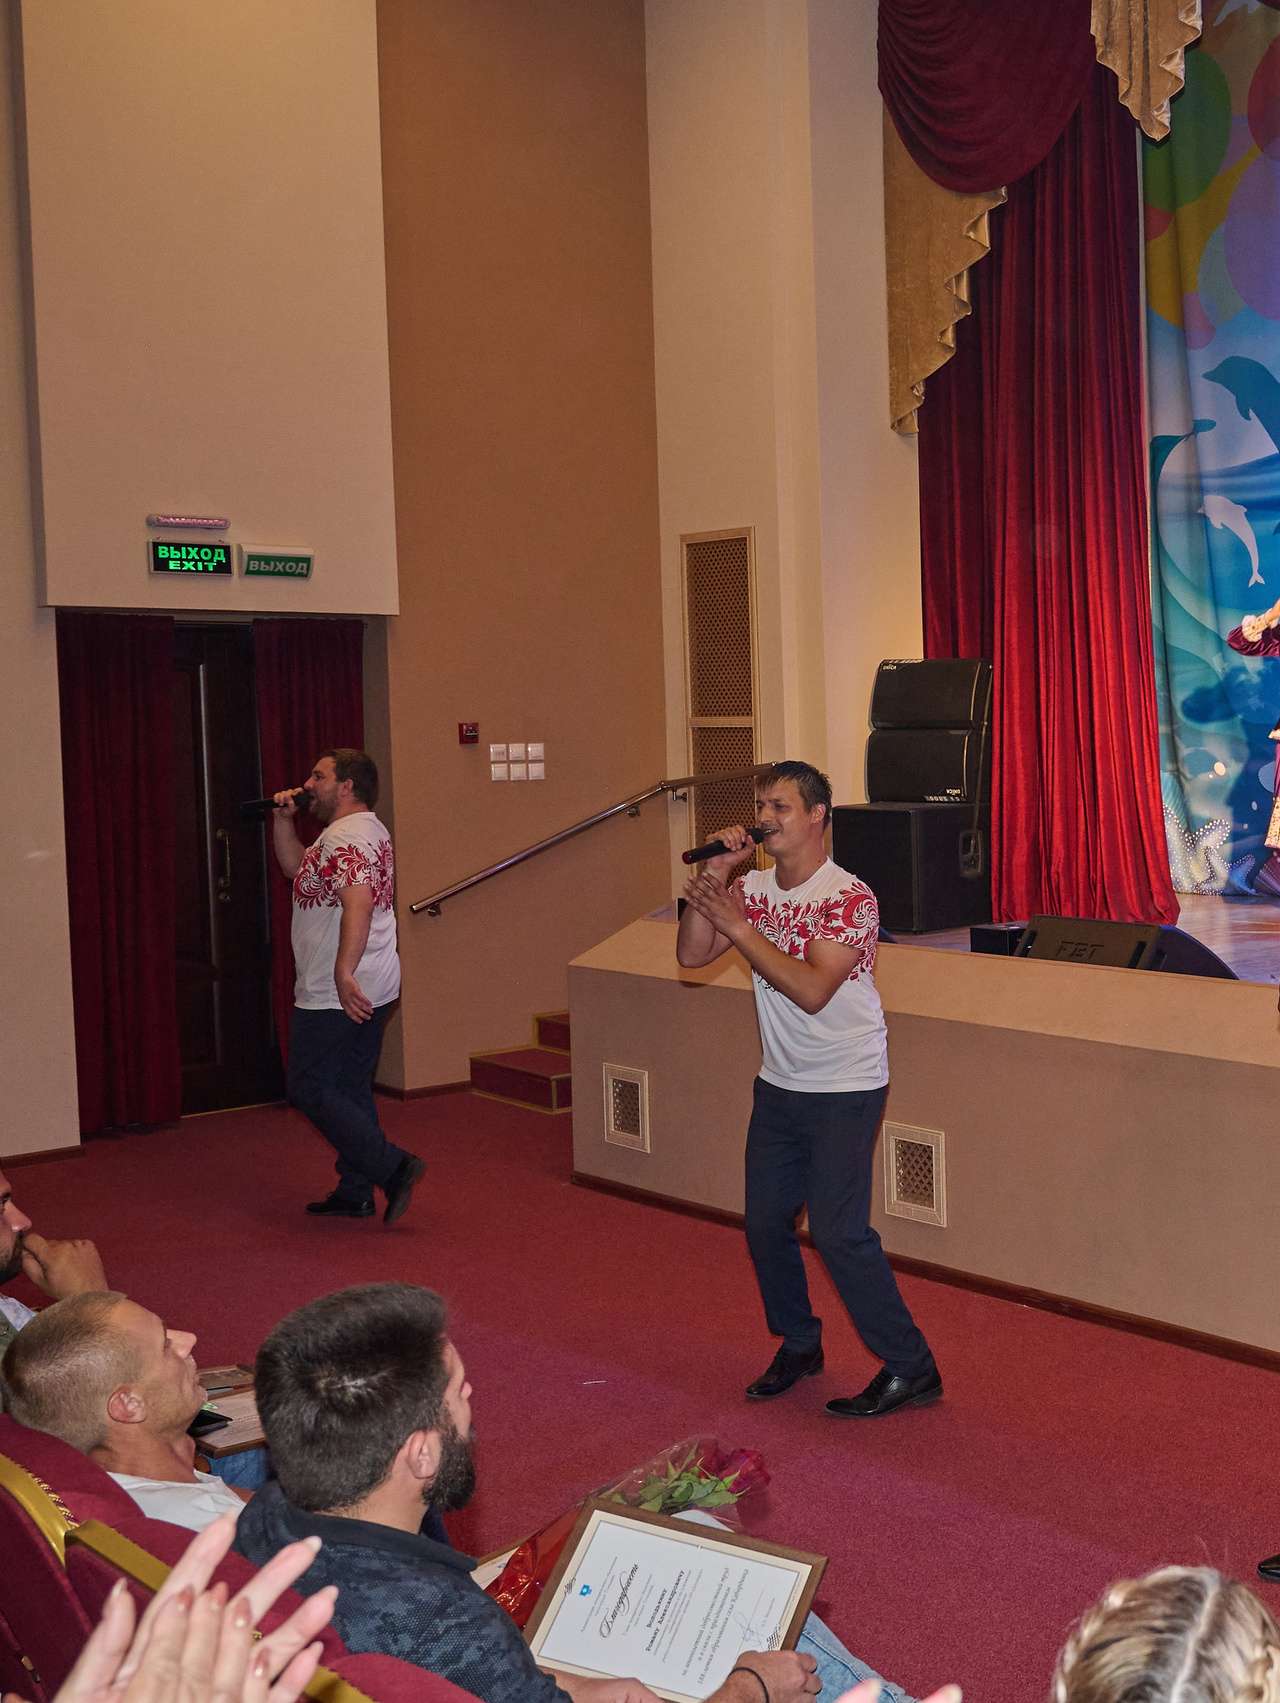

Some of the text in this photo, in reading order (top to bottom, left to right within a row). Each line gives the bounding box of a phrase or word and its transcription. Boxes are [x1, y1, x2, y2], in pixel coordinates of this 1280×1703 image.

[158, 546, 226, 563] ВЫХОД
[168, 560, 217, 571] EXIT
[250, 560, 307, 574] ВЫХОД
[598, 1562, 639, 1638] Благодарность
[644, 1626, 660, 1651] Роману
